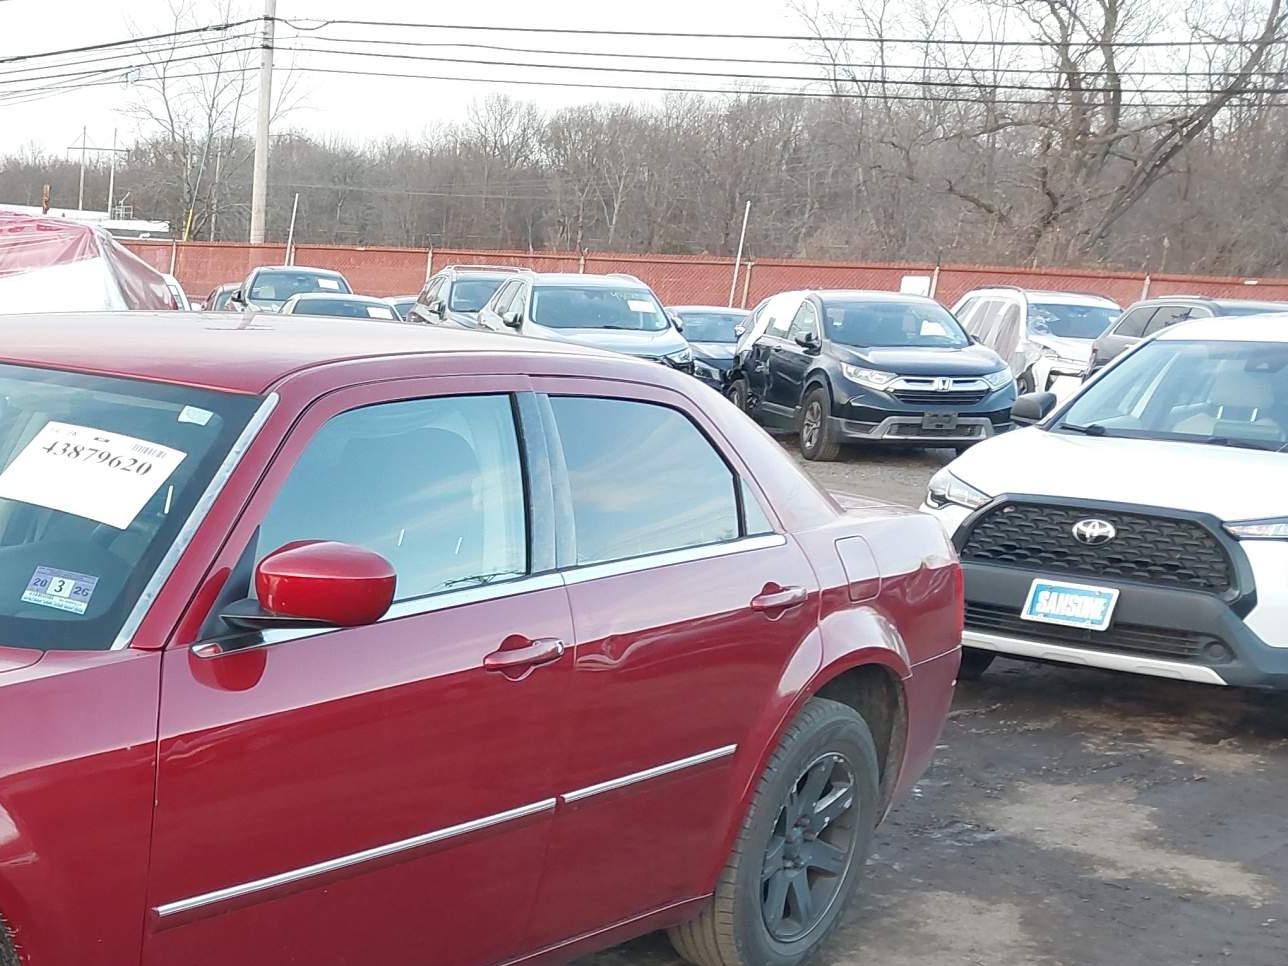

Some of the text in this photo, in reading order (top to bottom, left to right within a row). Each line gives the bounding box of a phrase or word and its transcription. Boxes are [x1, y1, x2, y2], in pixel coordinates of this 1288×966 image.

[42, 440, 153, 476] 43879620
[33, 577, 90, 597] 20 3 26
